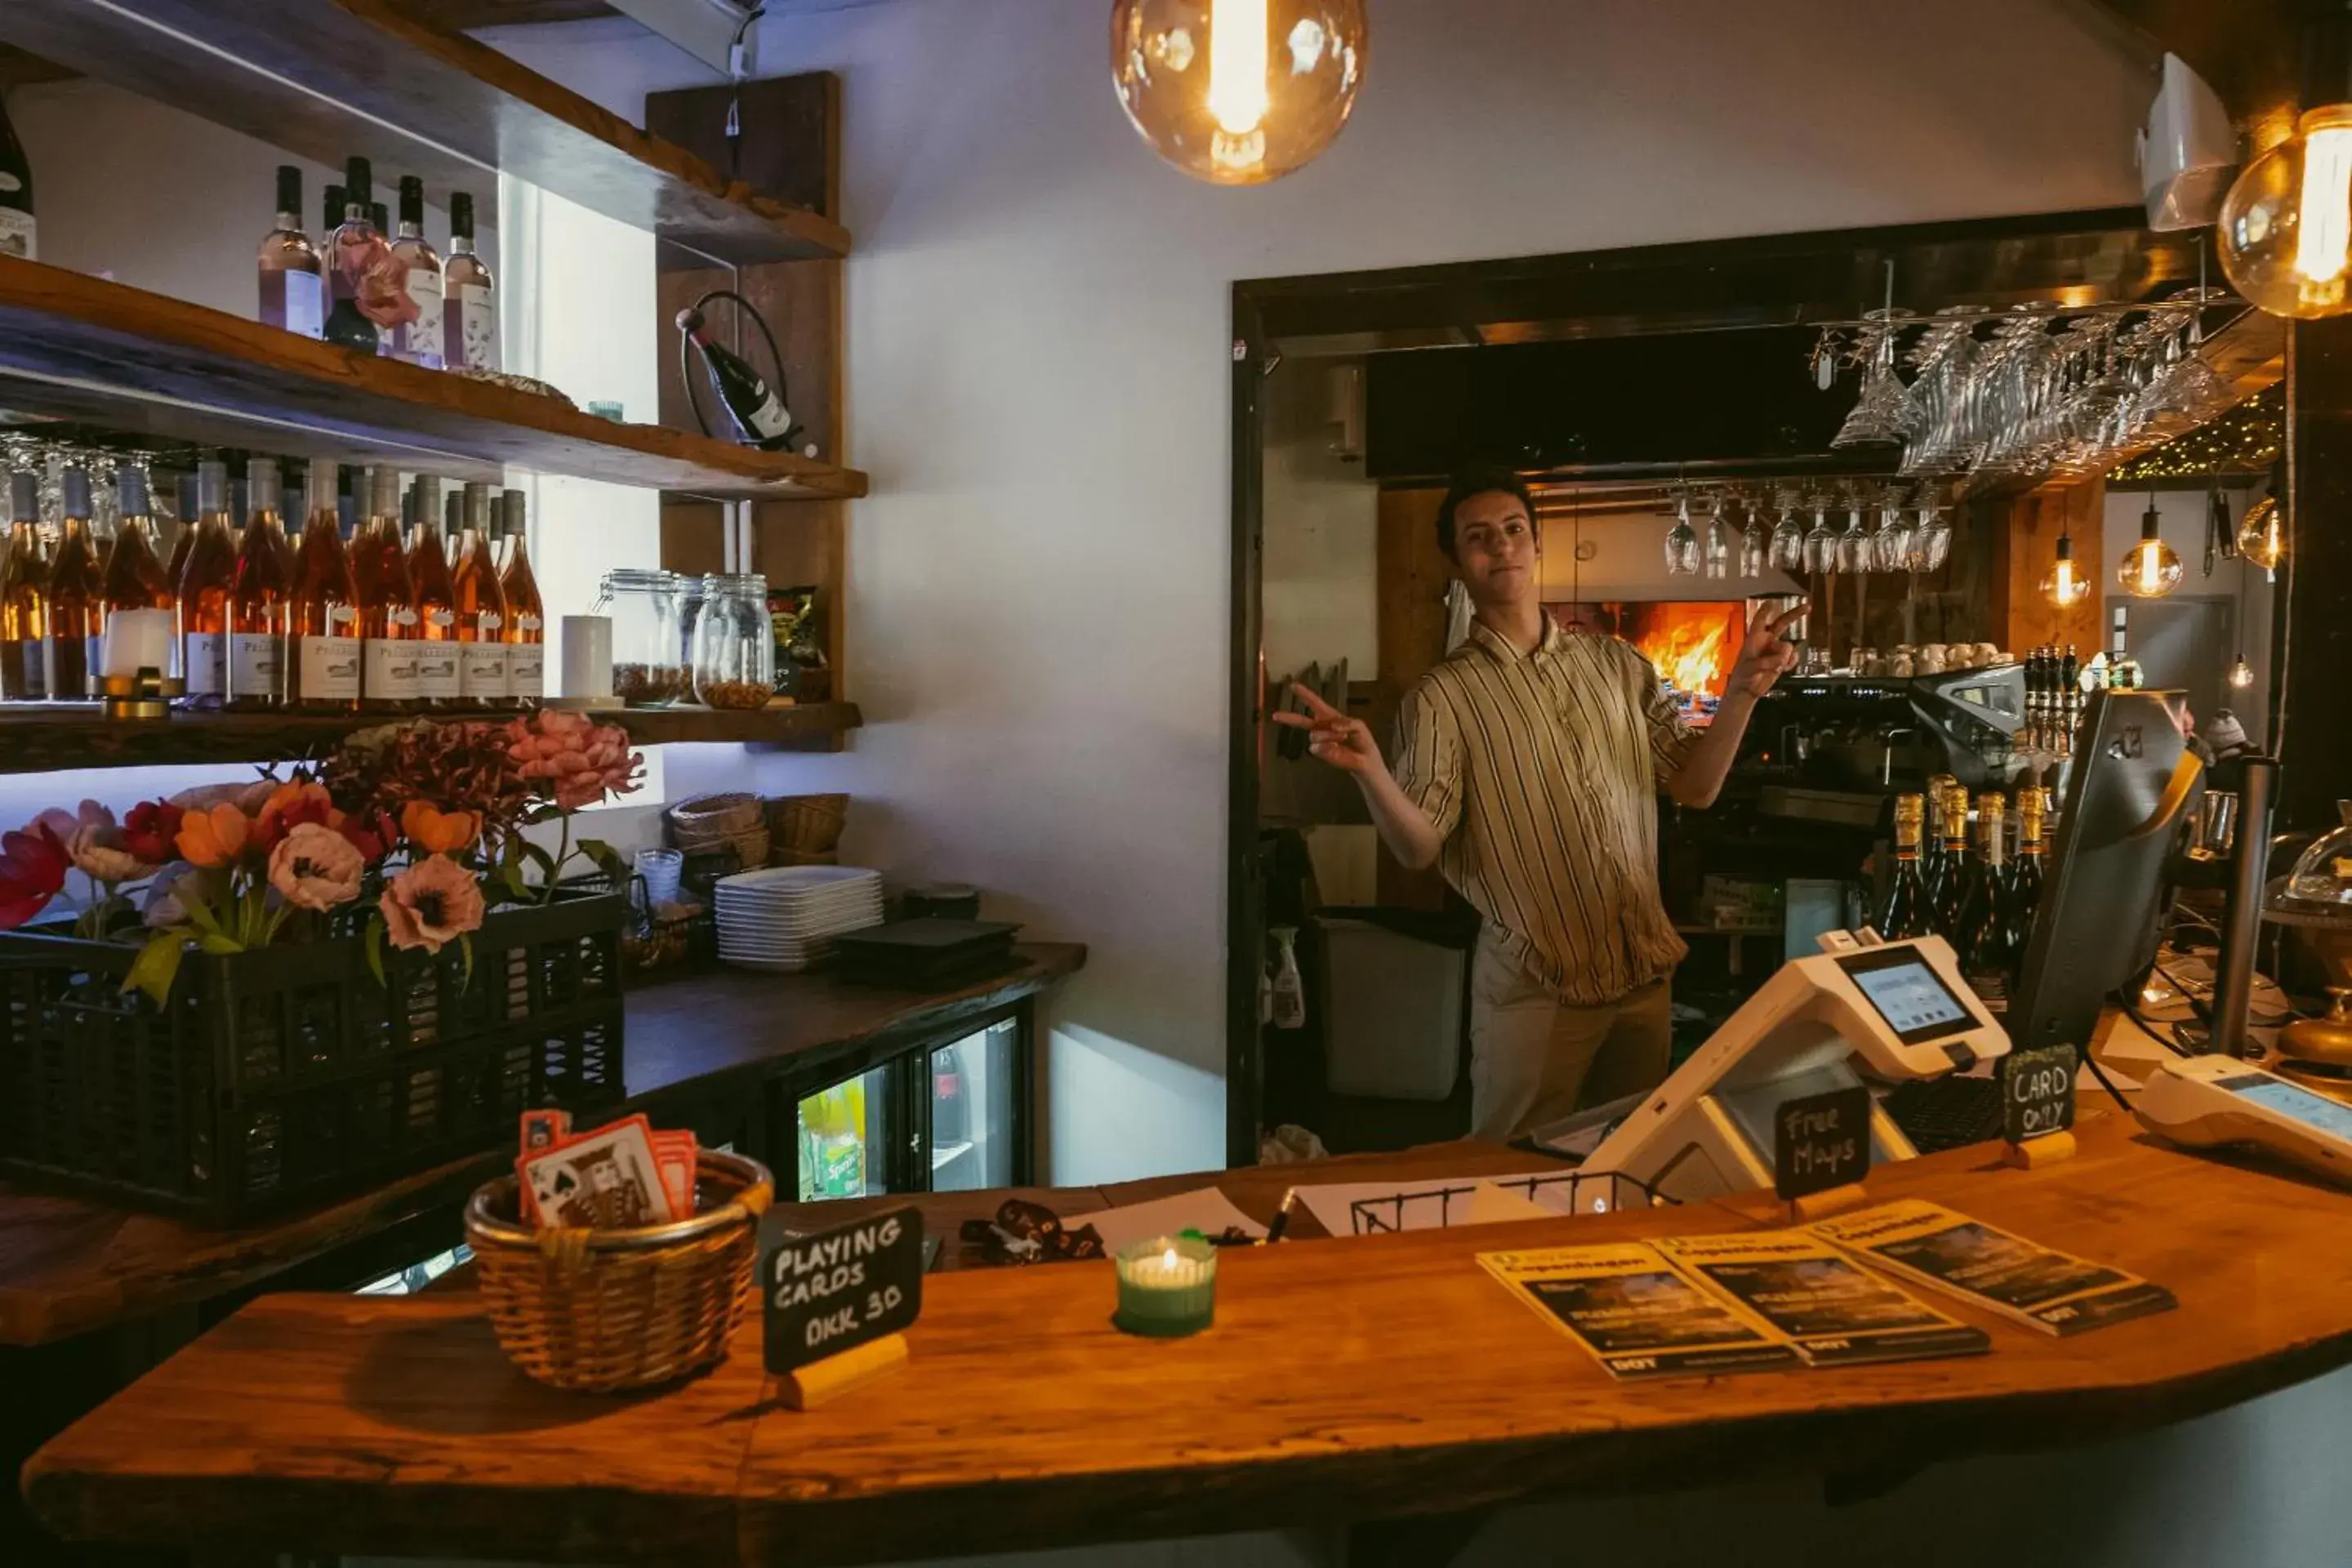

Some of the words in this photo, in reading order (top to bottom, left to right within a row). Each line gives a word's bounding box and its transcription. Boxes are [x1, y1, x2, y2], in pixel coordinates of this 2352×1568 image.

[2015, 1067, 2068, 1102] CARD
[776, 1218, 902, 1282] PLAYING
[775, 1262, 866, 1310] CARDS
[806, 1305, 860, 1349] DKK
[865, 1285, 903, 1321] 30
